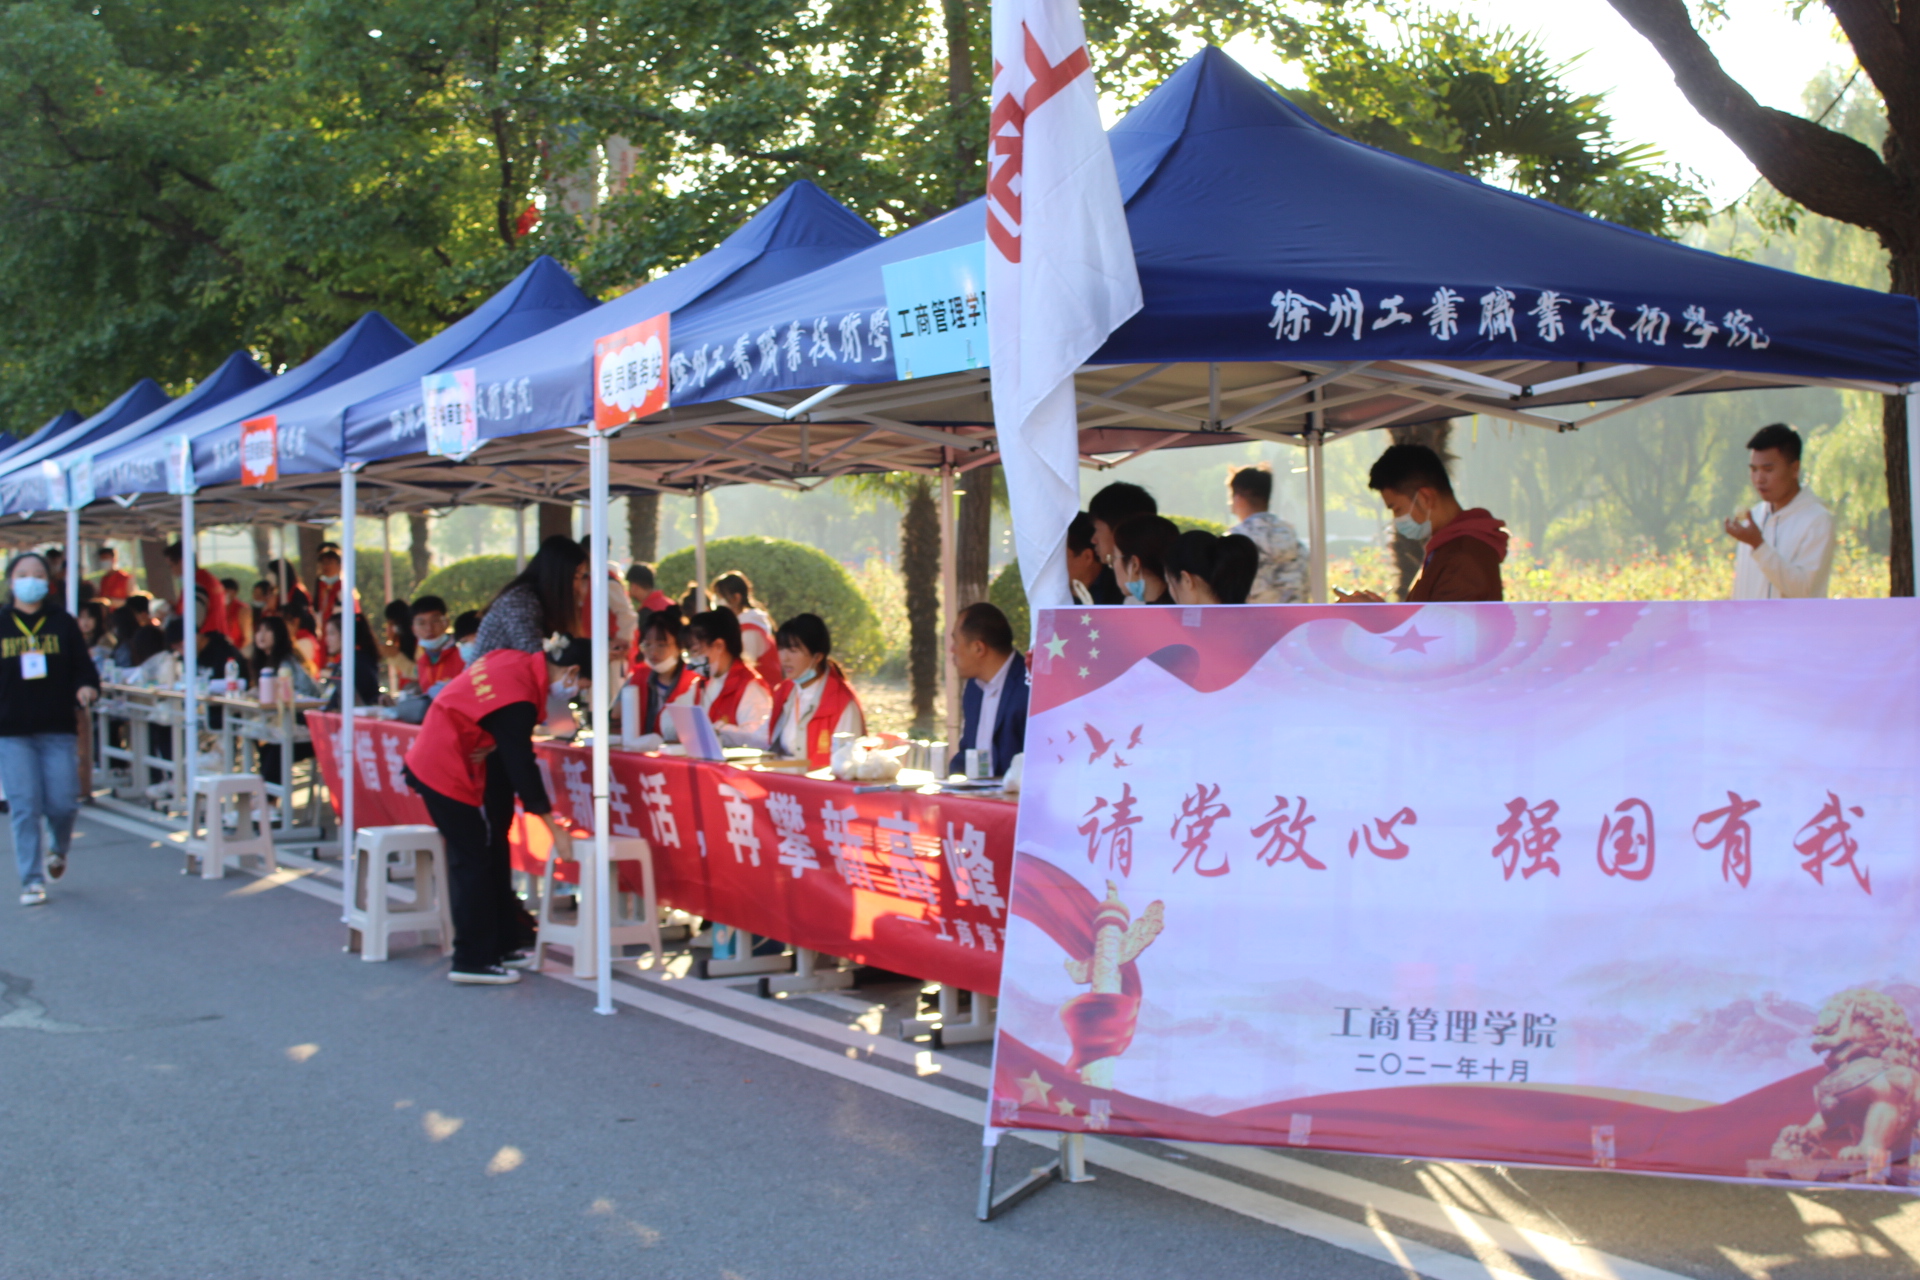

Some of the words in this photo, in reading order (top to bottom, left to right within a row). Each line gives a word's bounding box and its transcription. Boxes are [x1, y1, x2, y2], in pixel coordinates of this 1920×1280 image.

[1077, 783, 1418, 878] 请党放心
[1491, 789, 1873, 896] 强国有我
[1330, 1006, 1557, 1048] 工商管理学院
